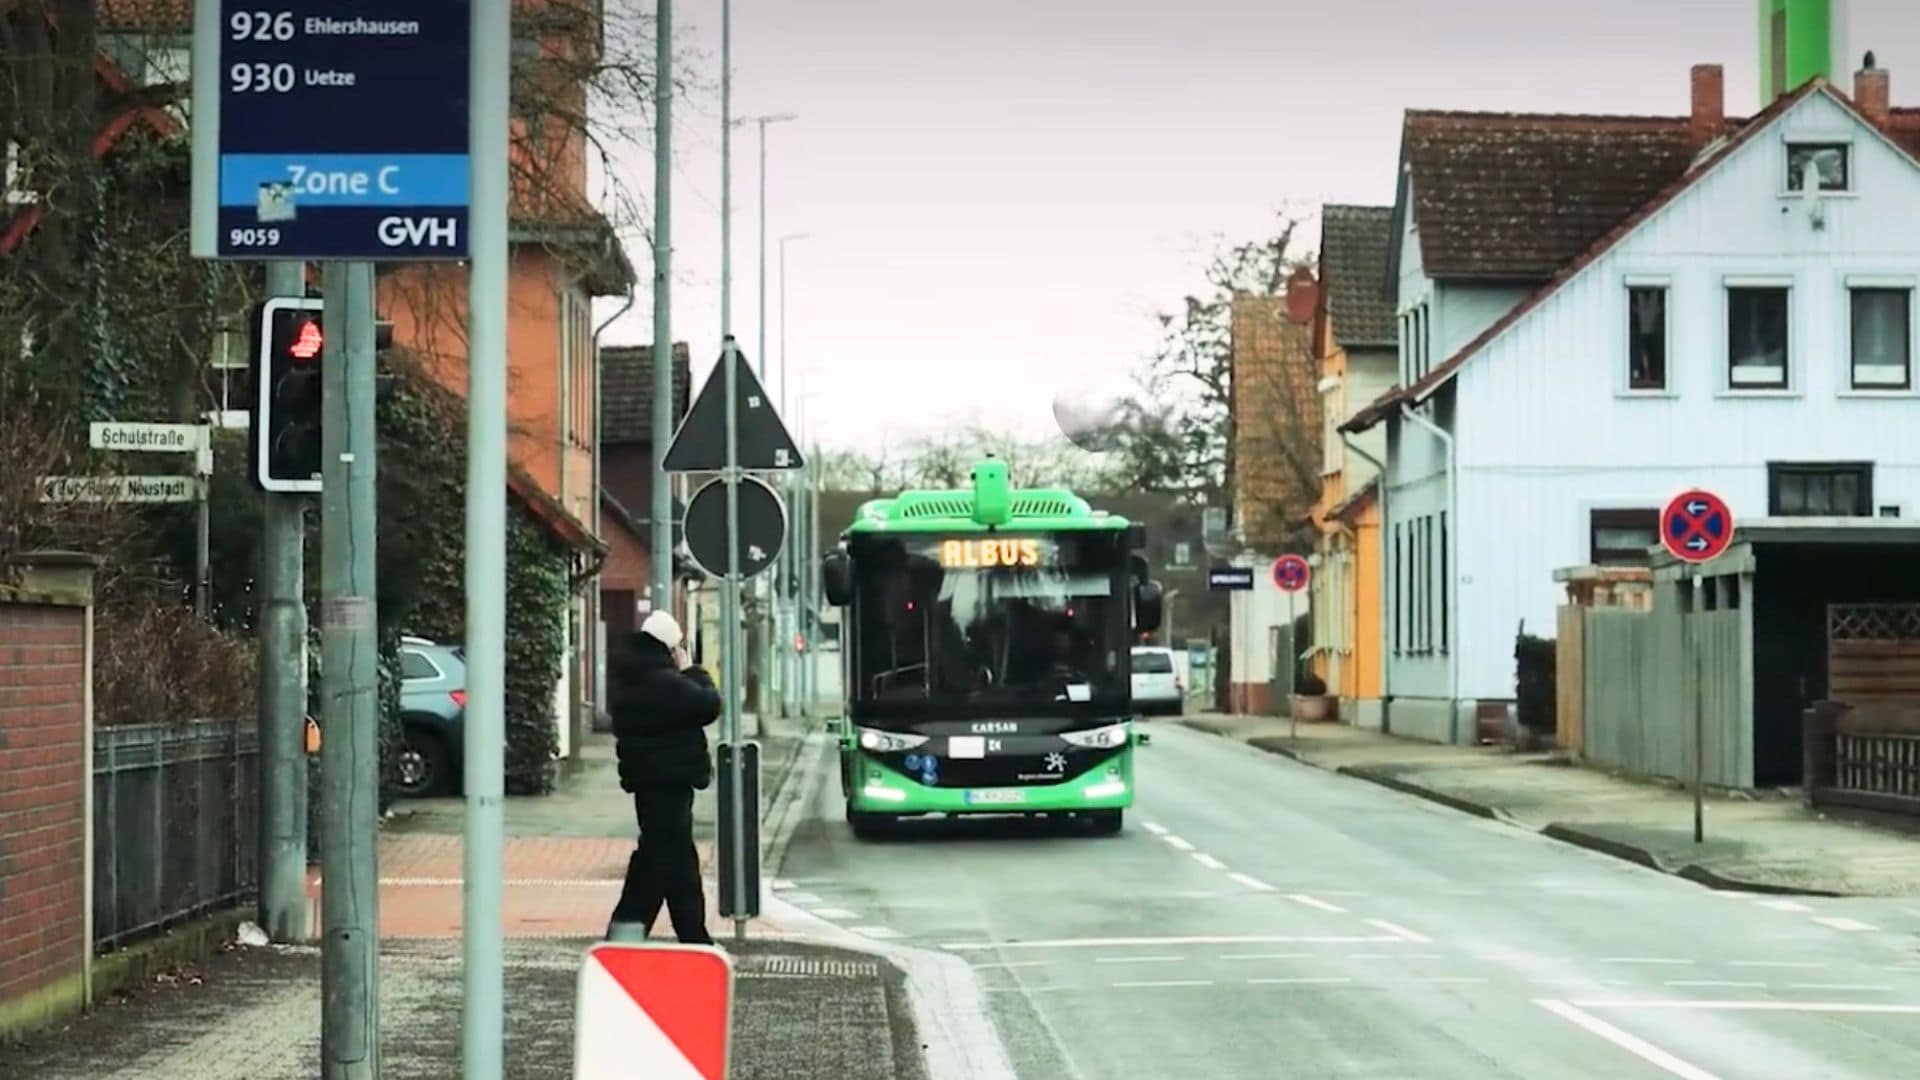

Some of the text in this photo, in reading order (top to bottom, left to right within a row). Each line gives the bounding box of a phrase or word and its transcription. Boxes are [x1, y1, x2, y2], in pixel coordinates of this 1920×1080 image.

[230, 11, 419, 41] 926 Ehlershausen
[230, 63, 355, 92] 930 Uetze
[286, 165, 400, 195] Zone C
[230, 229, 280, 246] 9059
[377, 216, 456, 247] GVH
[102, 427, 185, 446] Schulstraße
[128, 481, 185, 496] Neustadt
[942, 539, 1039, 567] ALBUS
[971, 722, 1018, 733] KARSAN
